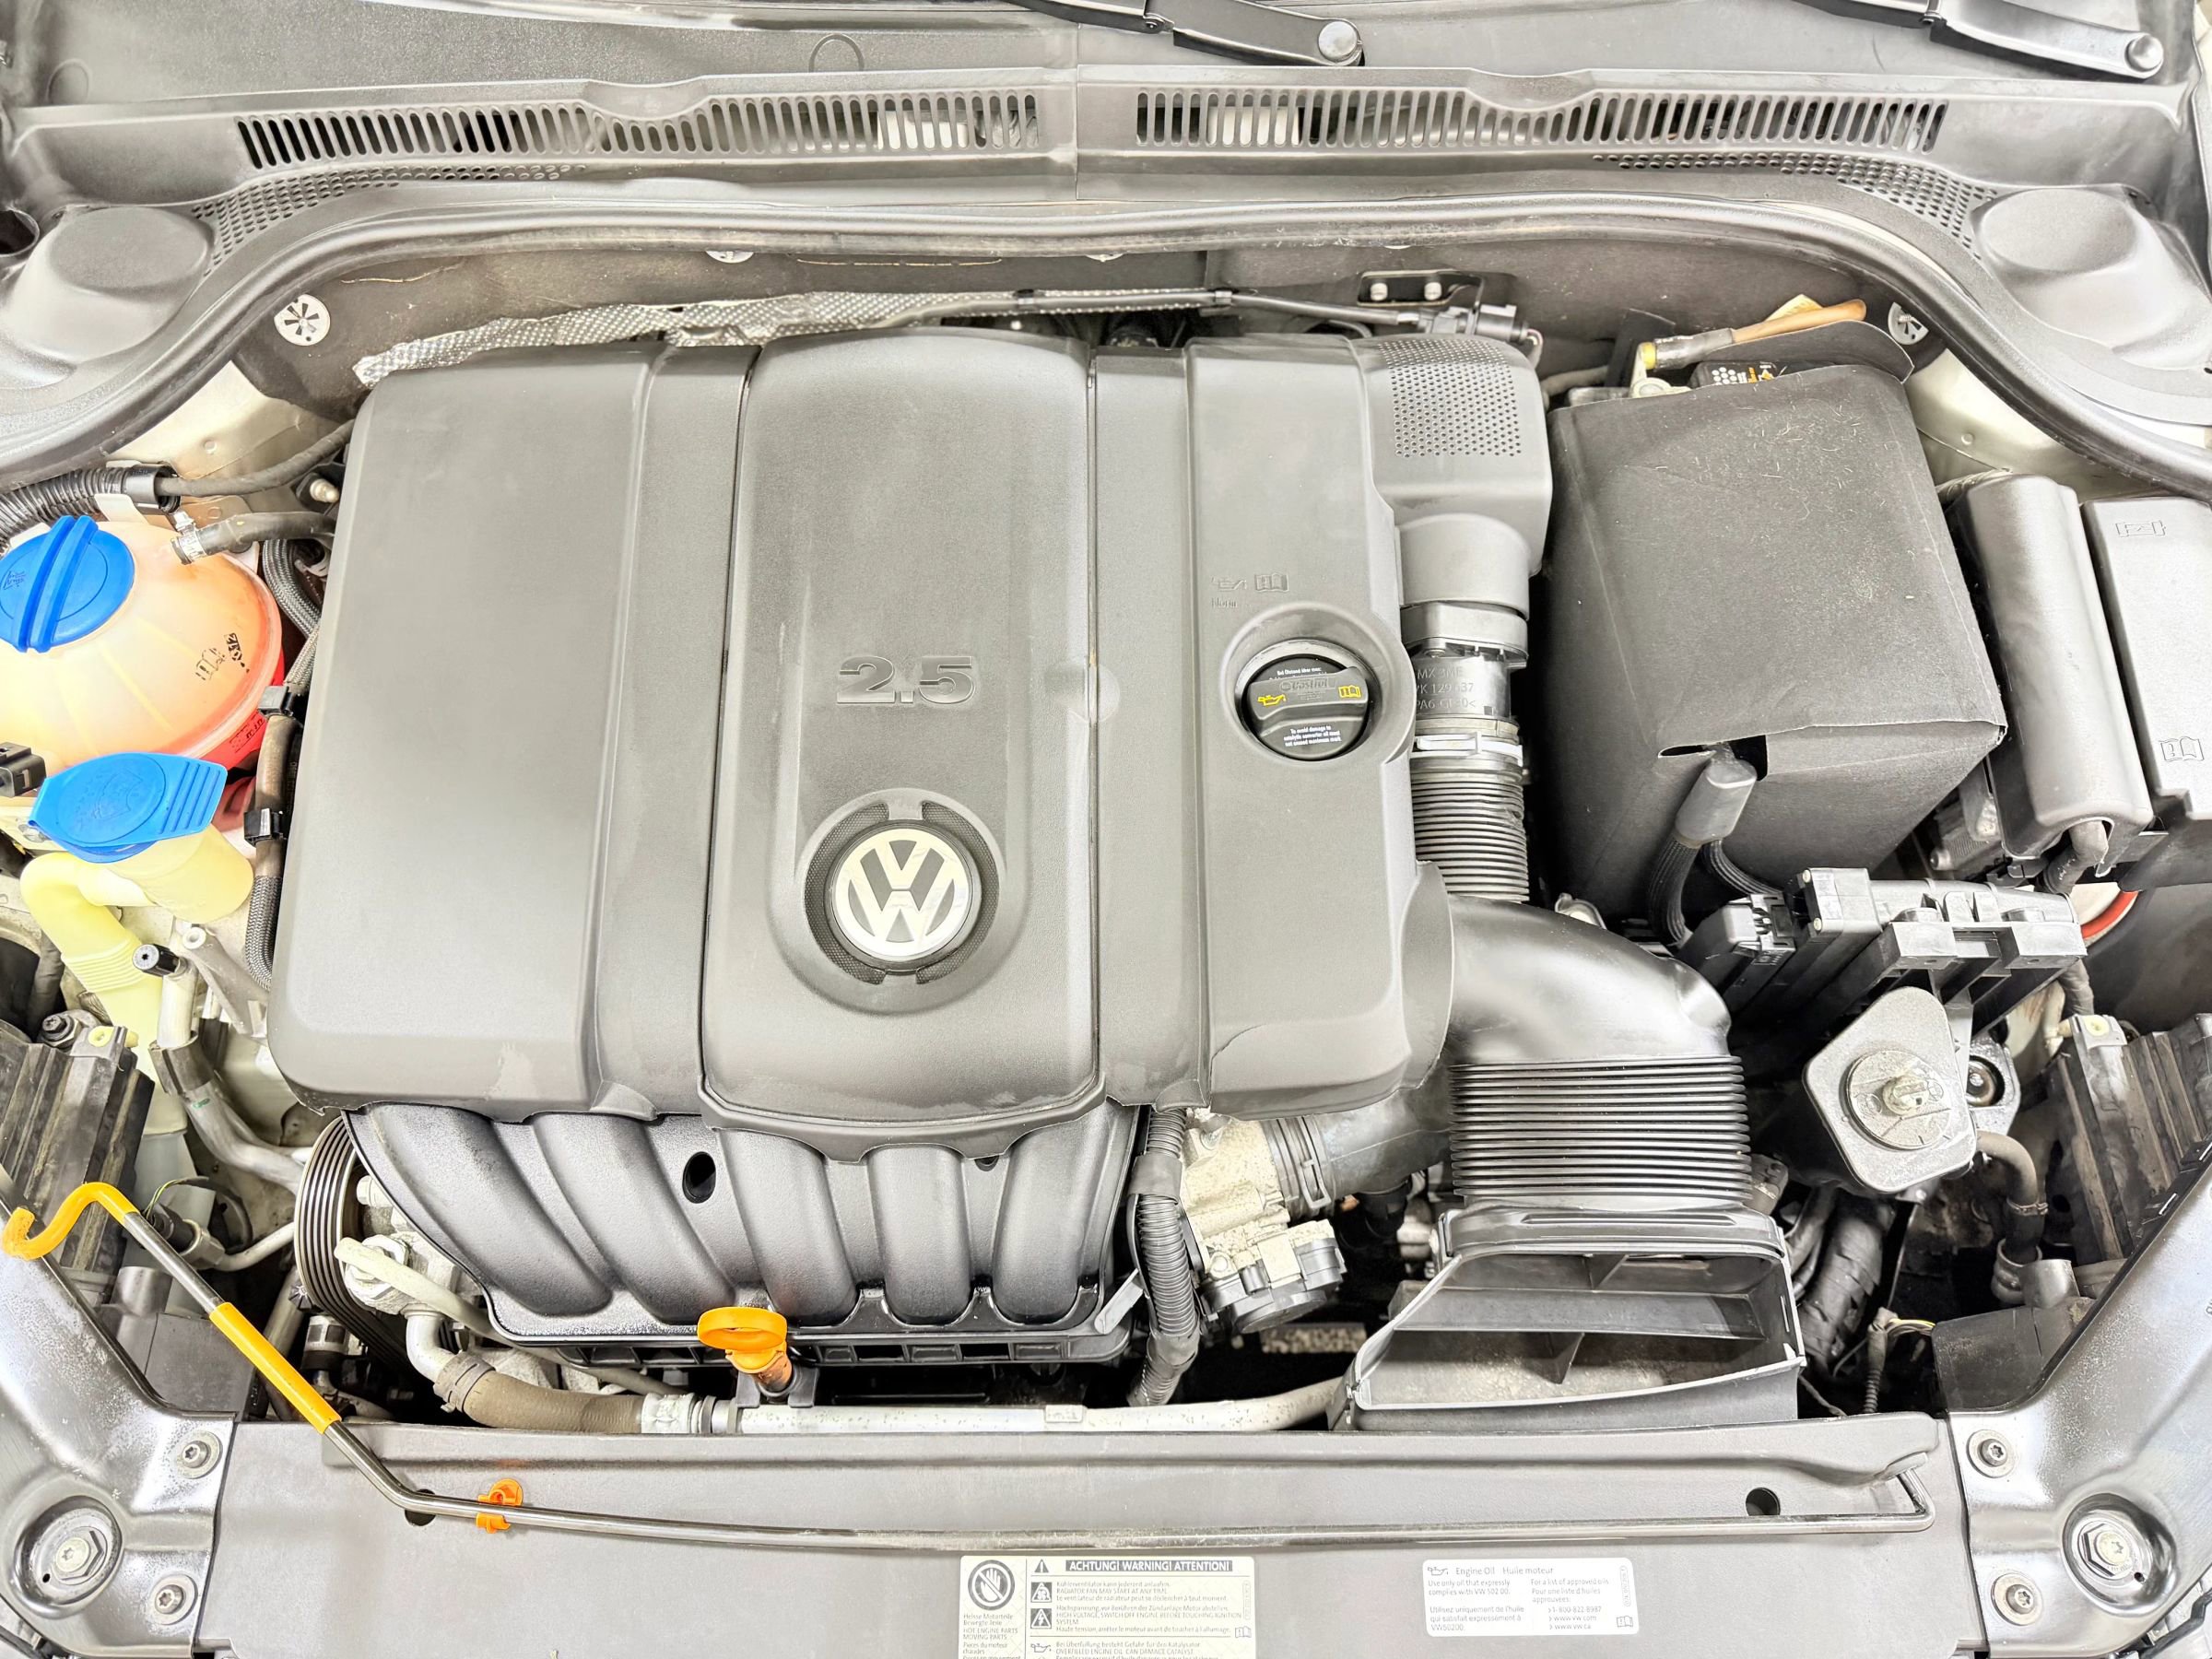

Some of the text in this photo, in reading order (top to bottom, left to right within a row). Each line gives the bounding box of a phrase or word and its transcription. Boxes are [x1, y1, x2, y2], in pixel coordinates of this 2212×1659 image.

[836, 655, 976, 704] 2.5
[835, 829, 969, 957] VW
[1069, 1560, 1230, 1571] ACHTUNG! WARNING! ATTENTION!
[1456, 1567, 1483, 1577] Engine
[1441, 1580, 1455, 1588] only
[1481, 1579, 1511, 1587] expressly
